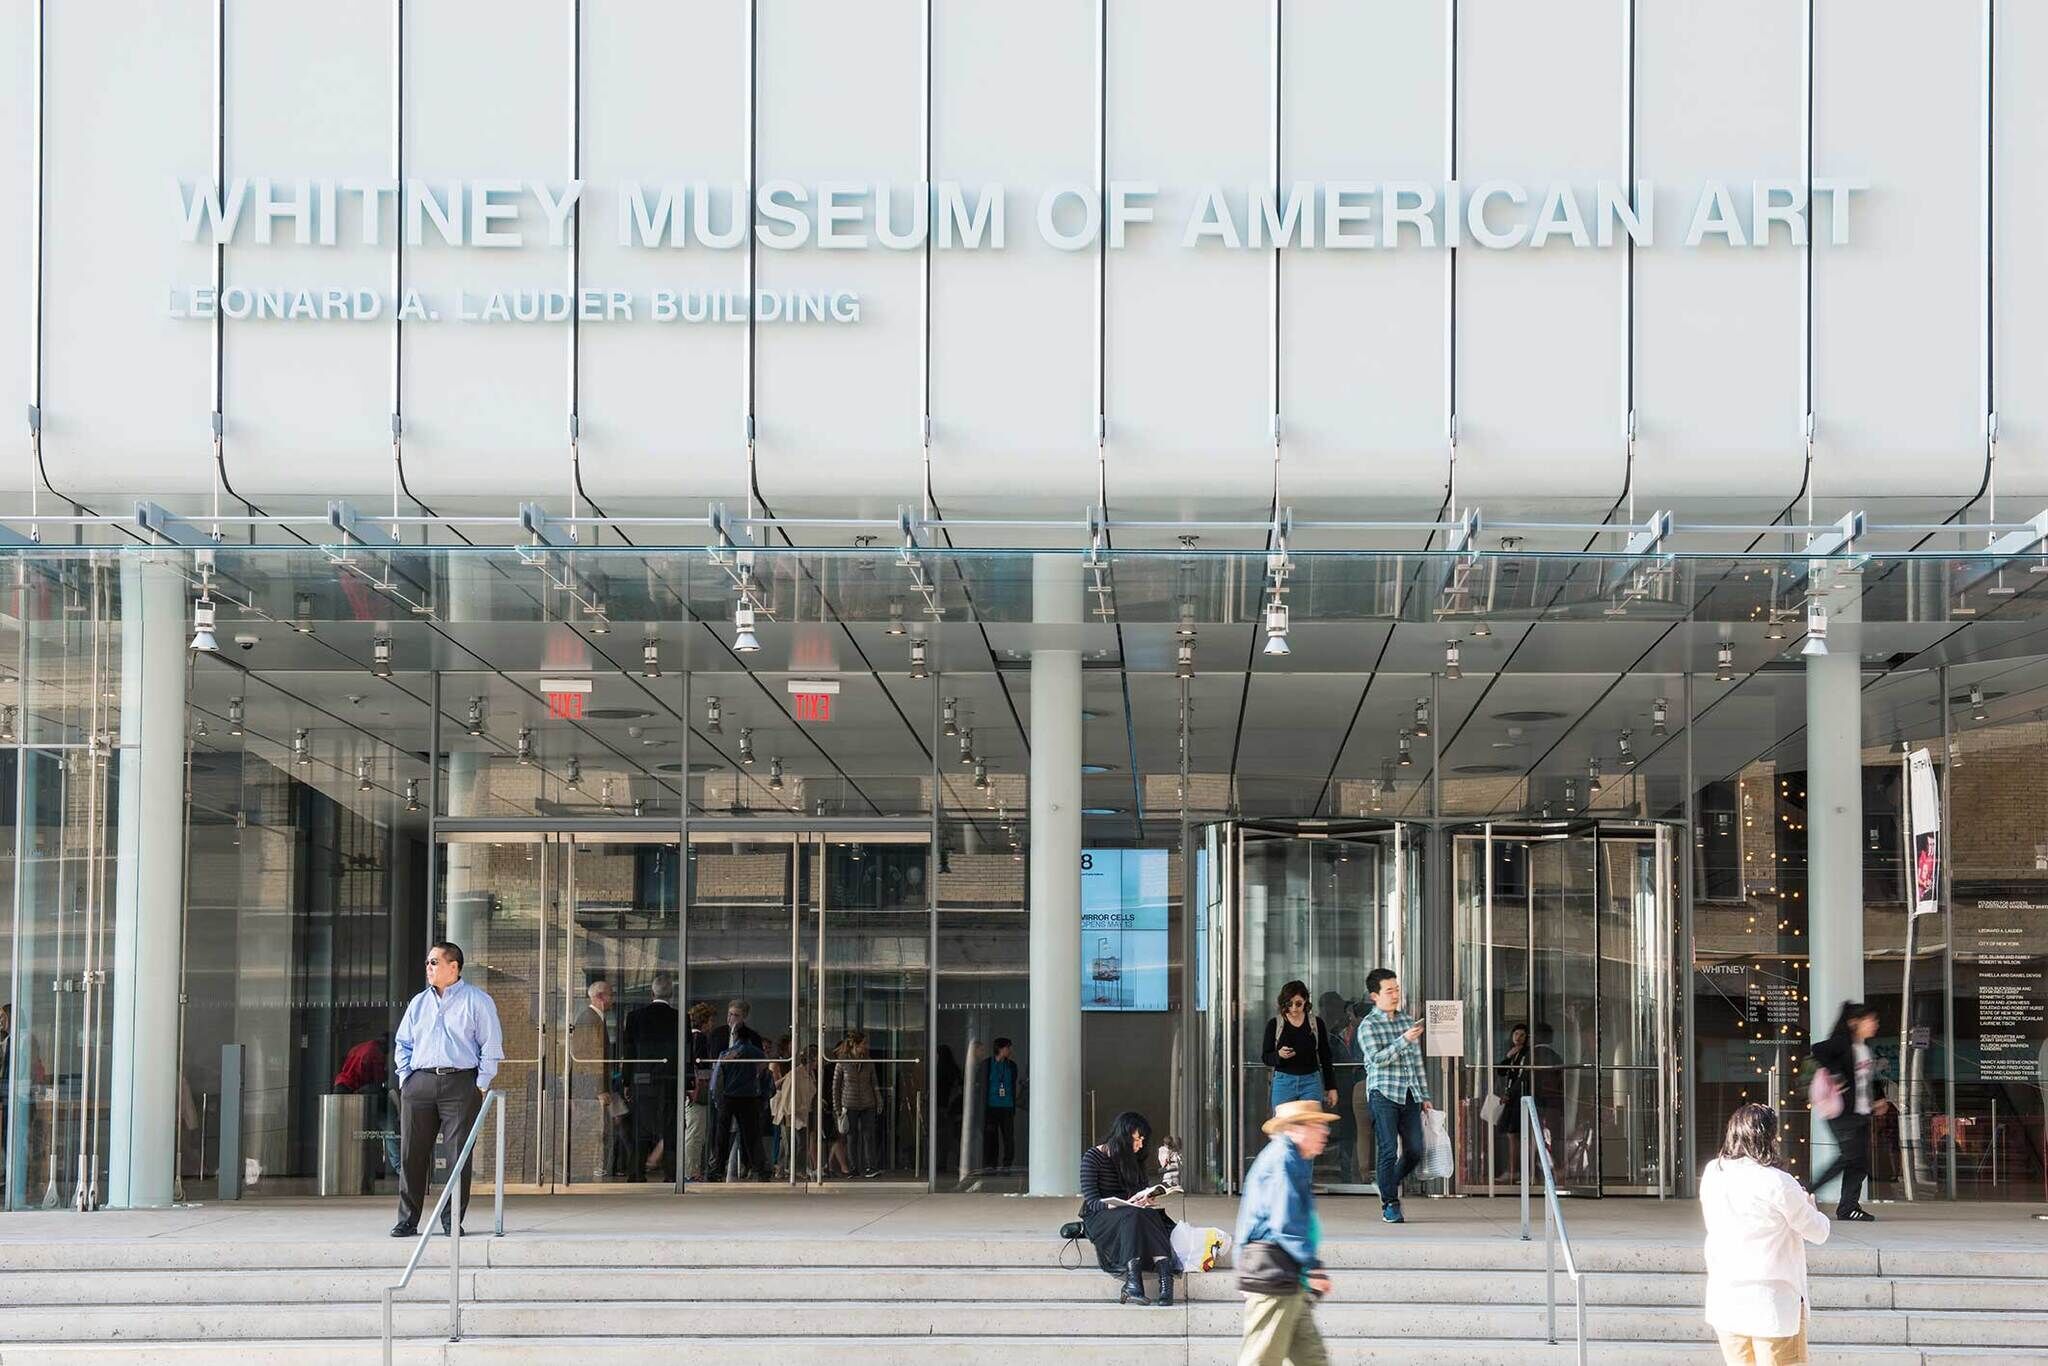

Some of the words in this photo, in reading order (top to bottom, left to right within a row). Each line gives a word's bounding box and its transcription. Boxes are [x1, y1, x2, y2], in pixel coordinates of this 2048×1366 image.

[177, 177, 586, 248] WHITNEY
[619, 179, 1007, 250] MUSEUM
[1036, 179, 1159, 251] OF
[1180, 178, 1654, 249] AMERICAN
[1685, 178, 1871, 247] ART
[170, 286, 383, 321] LEONARD
[397, 286, 440, 321] A.
[457, 287, 633, 322] LAUDER
[652, 288, 862, 323] BUILDING
[1081, 854, 1093, 870] 8
[1110, 913, 1136, 921] CELLS
[1702, 965, 1746, 974] WHITNEY
